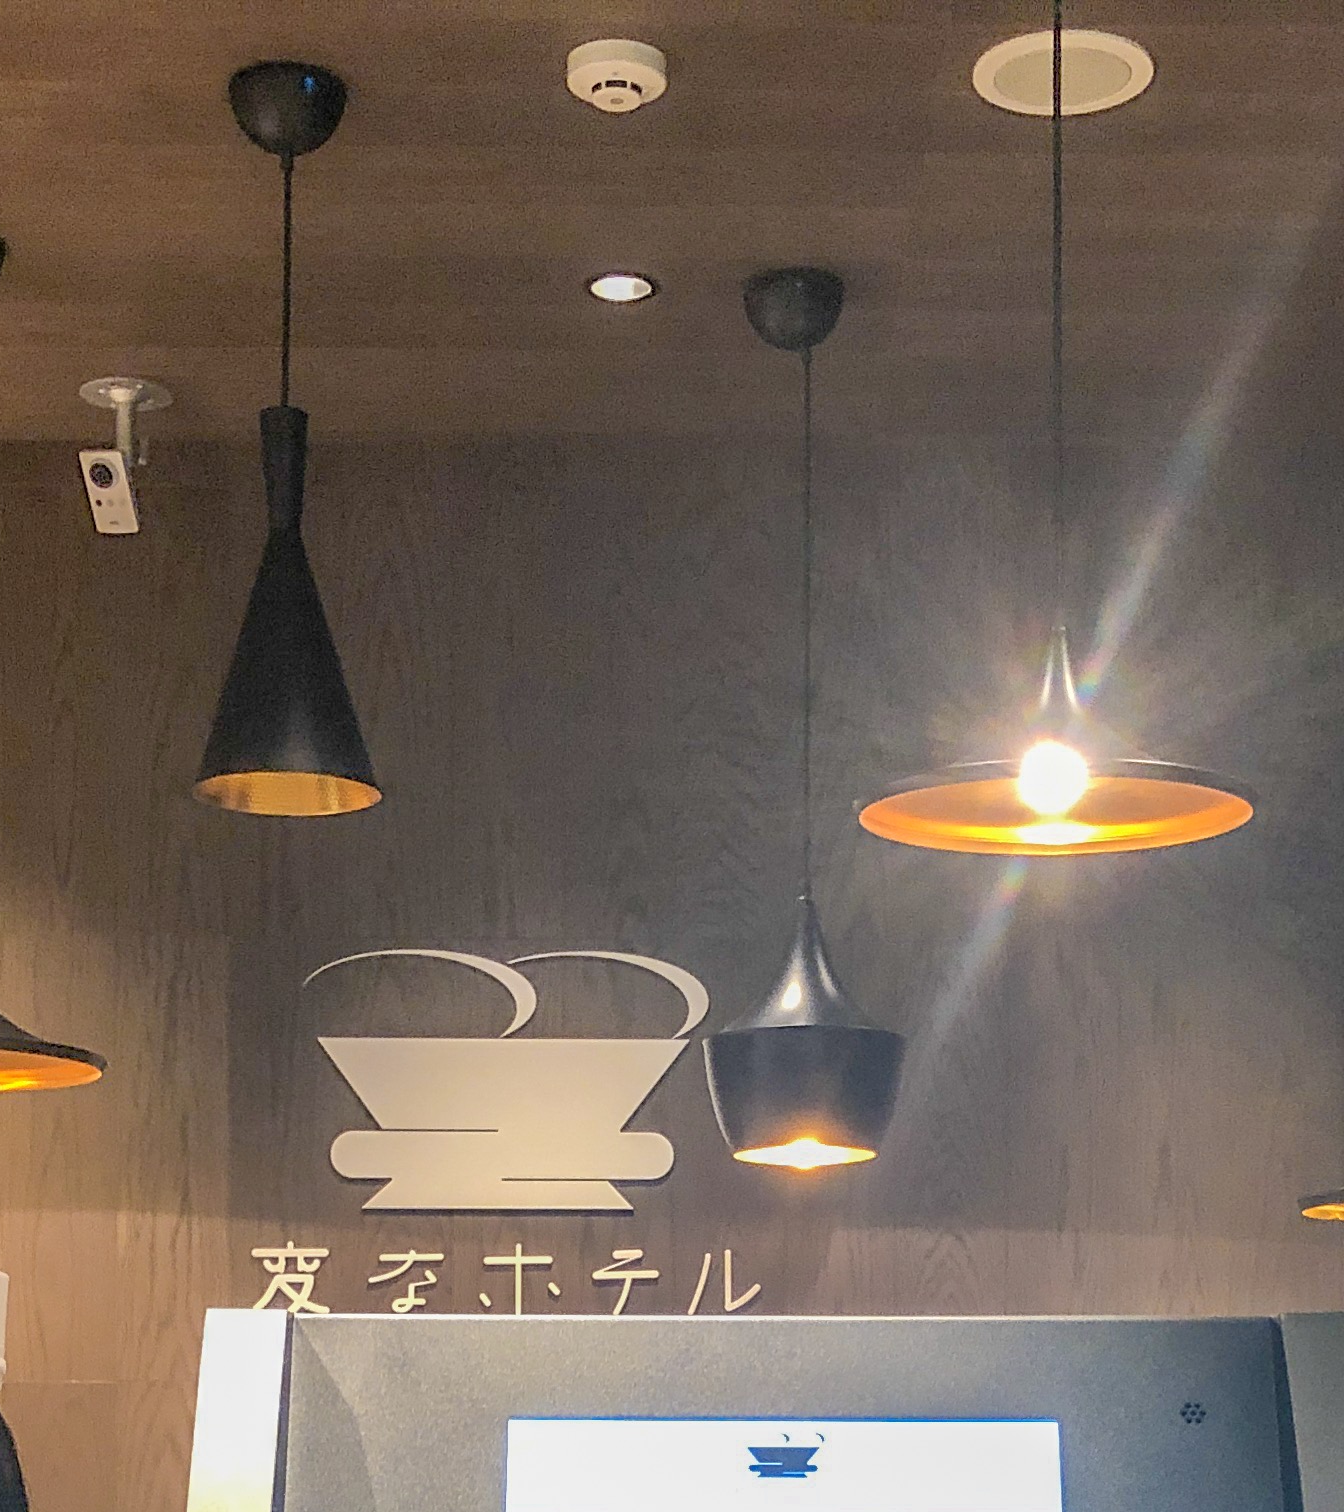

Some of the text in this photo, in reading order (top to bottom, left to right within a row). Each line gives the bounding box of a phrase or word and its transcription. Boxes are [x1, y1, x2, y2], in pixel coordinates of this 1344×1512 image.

[250, 1240, 762, 1316] 変なホテル
